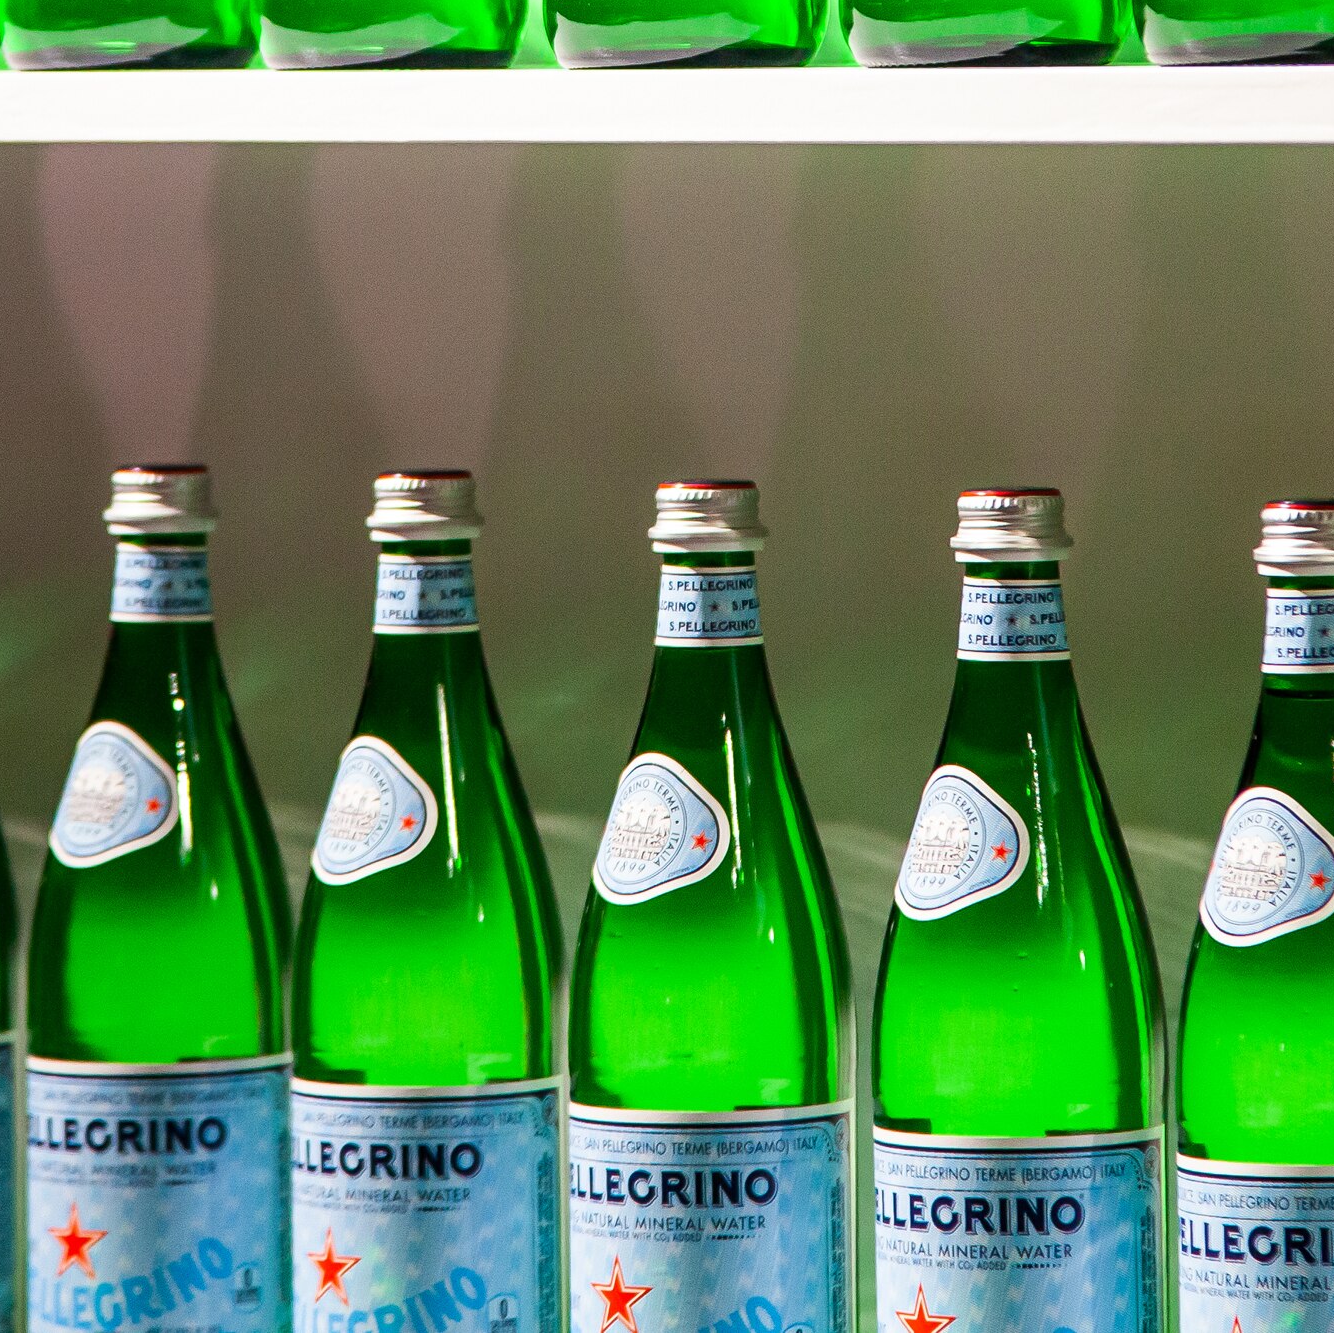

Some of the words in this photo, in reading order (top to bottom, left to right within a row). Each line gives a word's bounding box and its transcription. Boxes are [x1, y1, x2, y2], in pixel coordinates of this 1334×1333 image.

[668, 577, 753, 593] S.PELLEGRINO
[968, 591, 1055, 605] S.PELLEGRINO
[669, 618, 757, 634] S.PELLEGRINO
[968, 633, 1058, 647] S.PELLEGRINO
[653, 782, 680, 814] TERME
[951, 792, 978, 824] TERME
[653, 832, 680, 867] ITALIA
[602, 1138, 667, 1156] PELLEGRINO
[671, 1141, 713, 1156] TERME
[717, 1138, 790, 1158] (BERGAMO)
[905, 1166, 971, 1182] PELLEGRINO
[975, 1167, 1017, 1182] TERME
[1021, 1165, 1097, 1185] (BERGAMO)
[1219, 1194, 1291, 1212] PELLEGRINO
[581, 1213, 630, 1230] NATURAL
[634, 1216, 706, 1233] MINERAL
[711, 1215, 767, 1231] WATER
[886, 1240, 933, 1258] NATURAL
[938, 1243, 1010, 1260] MINERAL
[1016, 1243, 1073, 1259] WATER
[1195, 1270, 1250, 1289] NATURAL
[1254, 1274, 1332, 1291] MINERAL
